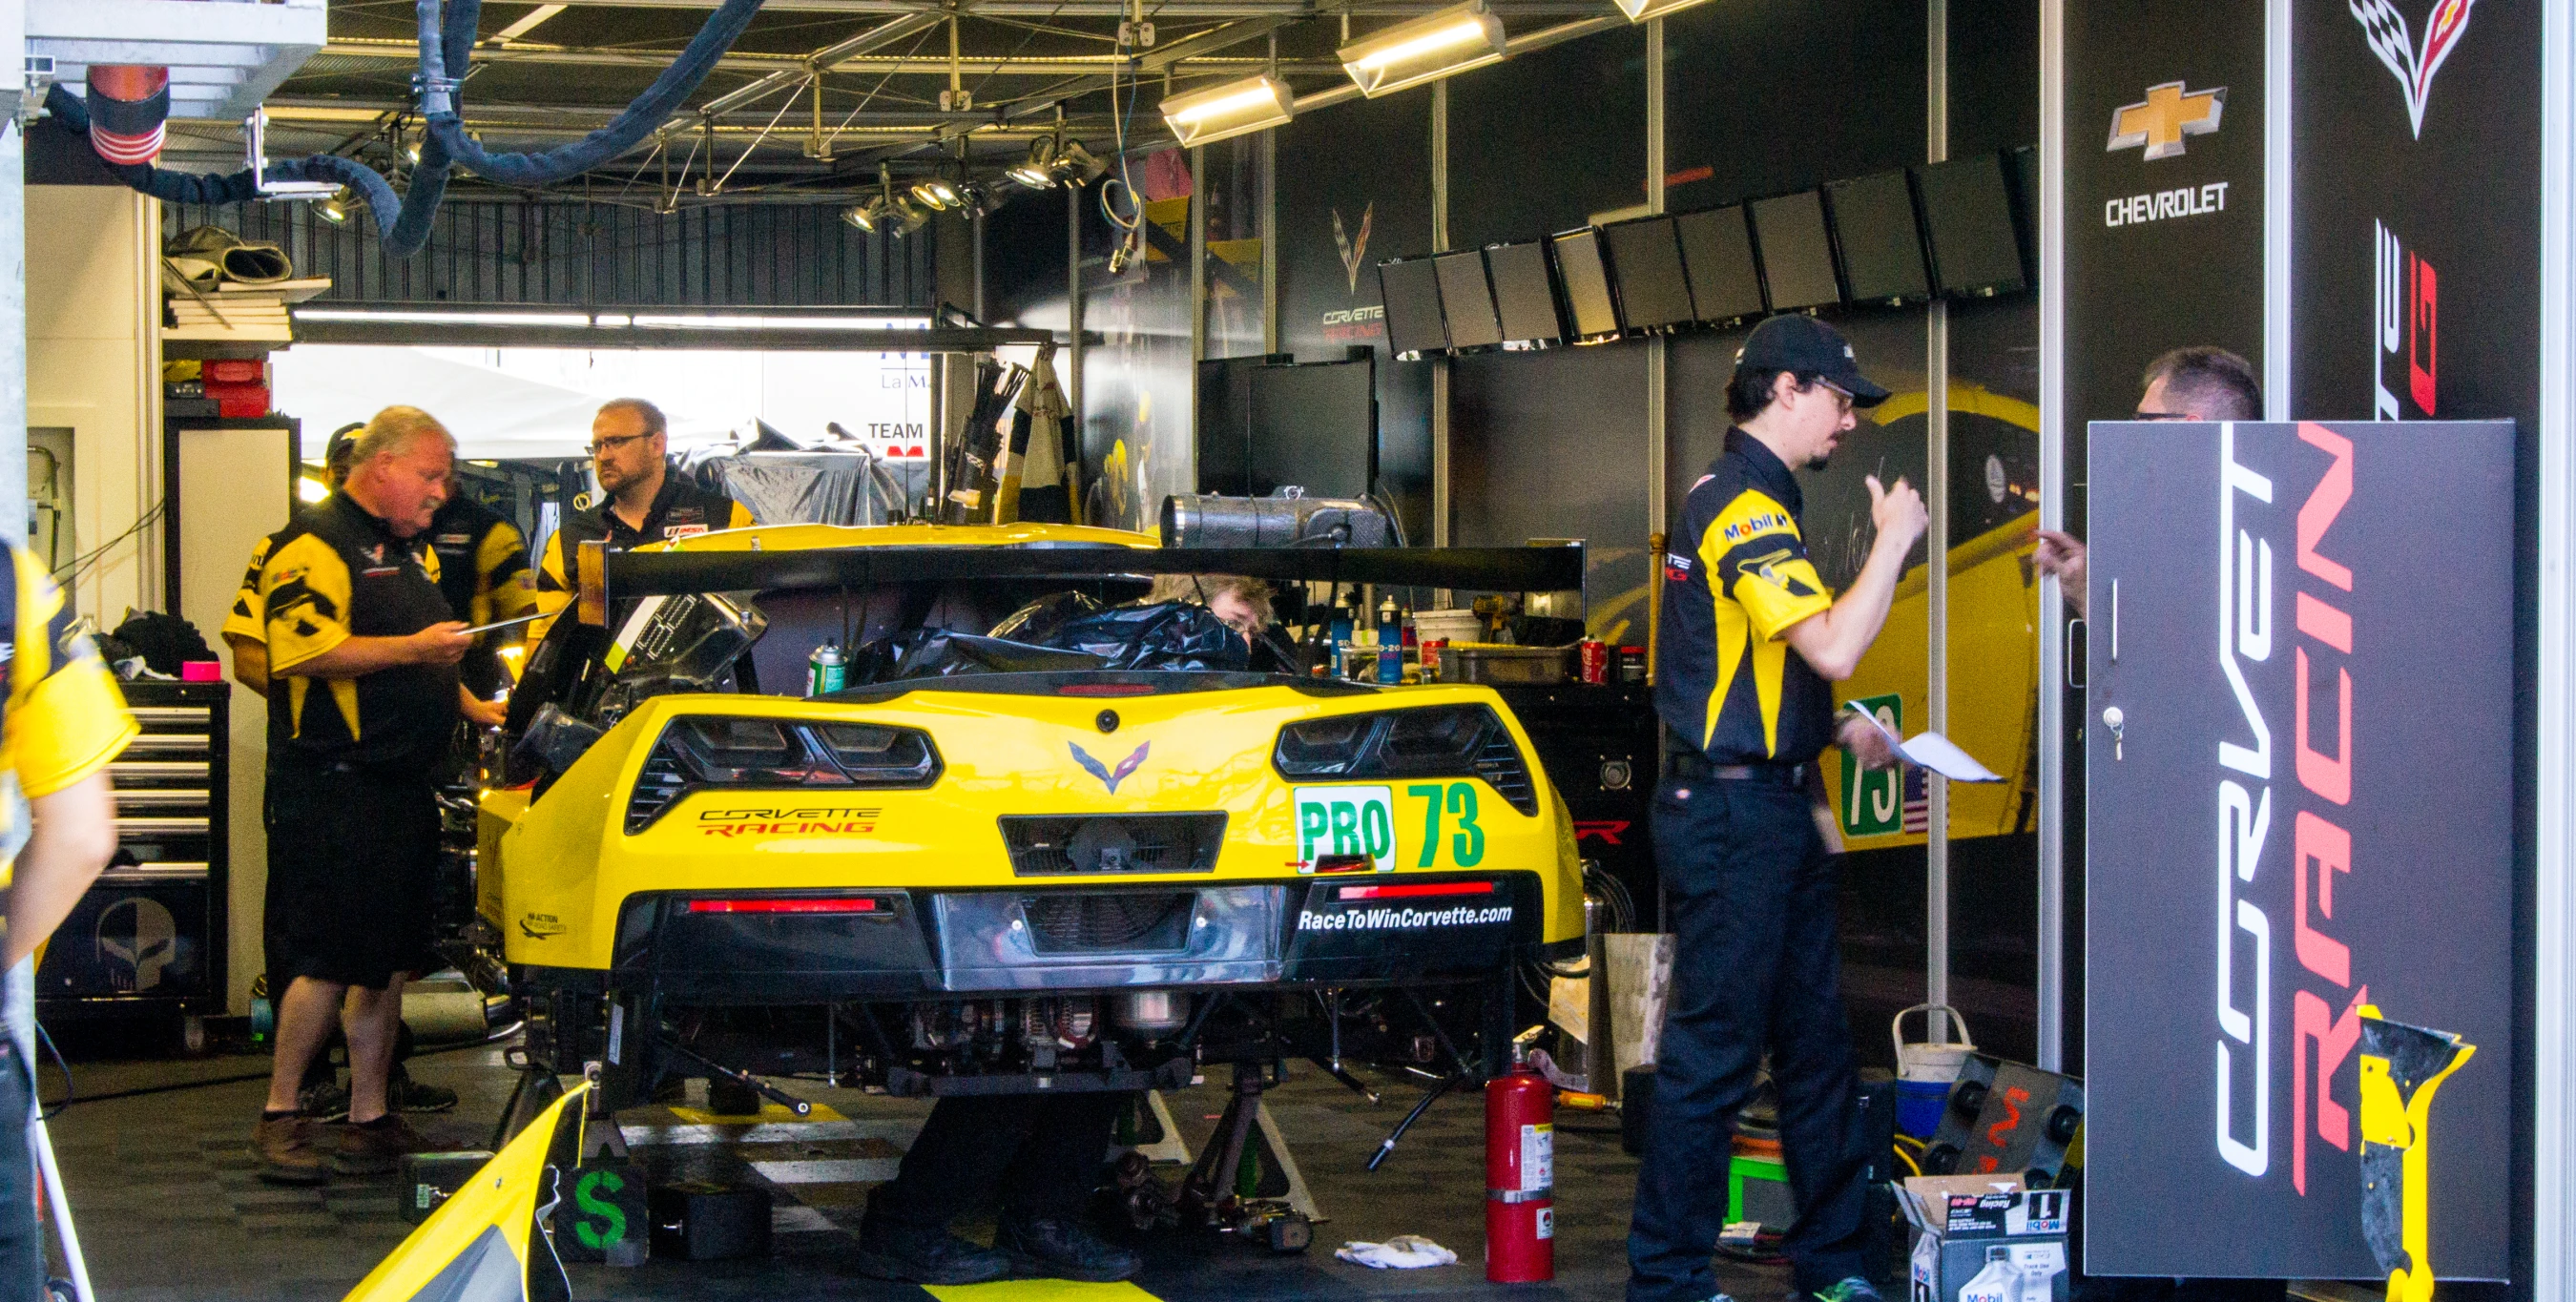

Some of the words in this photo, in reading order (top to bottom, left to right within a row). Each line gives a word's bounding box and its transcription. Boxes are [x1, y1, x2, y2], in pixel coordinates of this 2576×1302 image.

[2106, 181, 2228, 227] CHEVROLET
[1323, 305, 1384, 325] CORVETTE
[1322, 321, 1382, 344] RACING
[882, 374, 902, 389] La
[867, 423, 924, 439] TEAM
[1724, 514, 1773, 542] Mobil
[2216, 422, 2273, 1177] CORVET
[2293, 422, 2368, 1197] RACIN
[699, 807, 883, 821] CORVETTE
[1407, 781, 1485, 868] 73
[696, 821, 877, 837] RACING
[1300, 799, 1391, 861] PRO
[1298, 906, 1513, 930] RaceToWinCorvette.com
[575, 1170, 626, 1250] S
[1980, 1198, 2011, 1209] Racing
[2026, 1219, 2060, 1230] Mobil
[1966, 1292, 2003, 1302] Mobil
